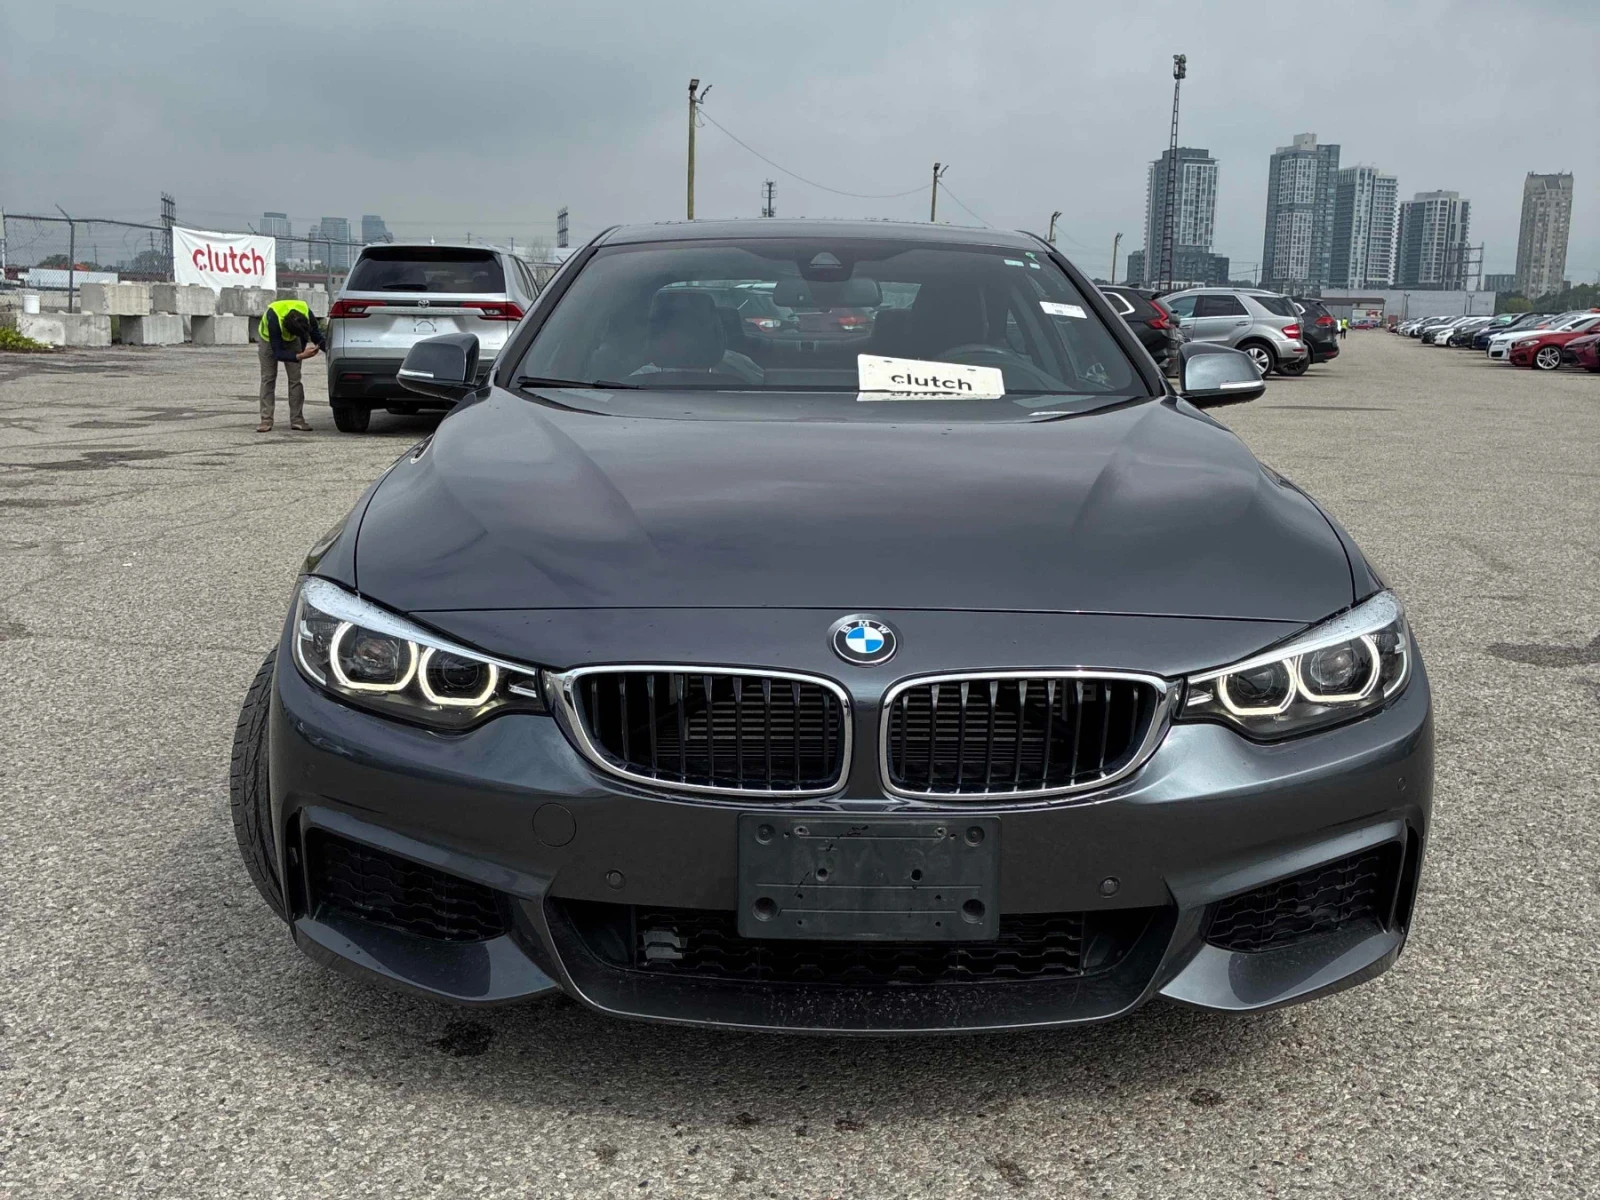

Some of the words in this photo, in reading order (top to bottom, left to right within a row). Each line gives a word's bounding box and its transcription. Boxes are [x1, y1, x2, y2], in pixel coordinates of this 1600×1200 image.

[192, 243, 265, 276] clutch
[891, 373, 973, 391] clutch
[840, 620, 890, 634] BMW
